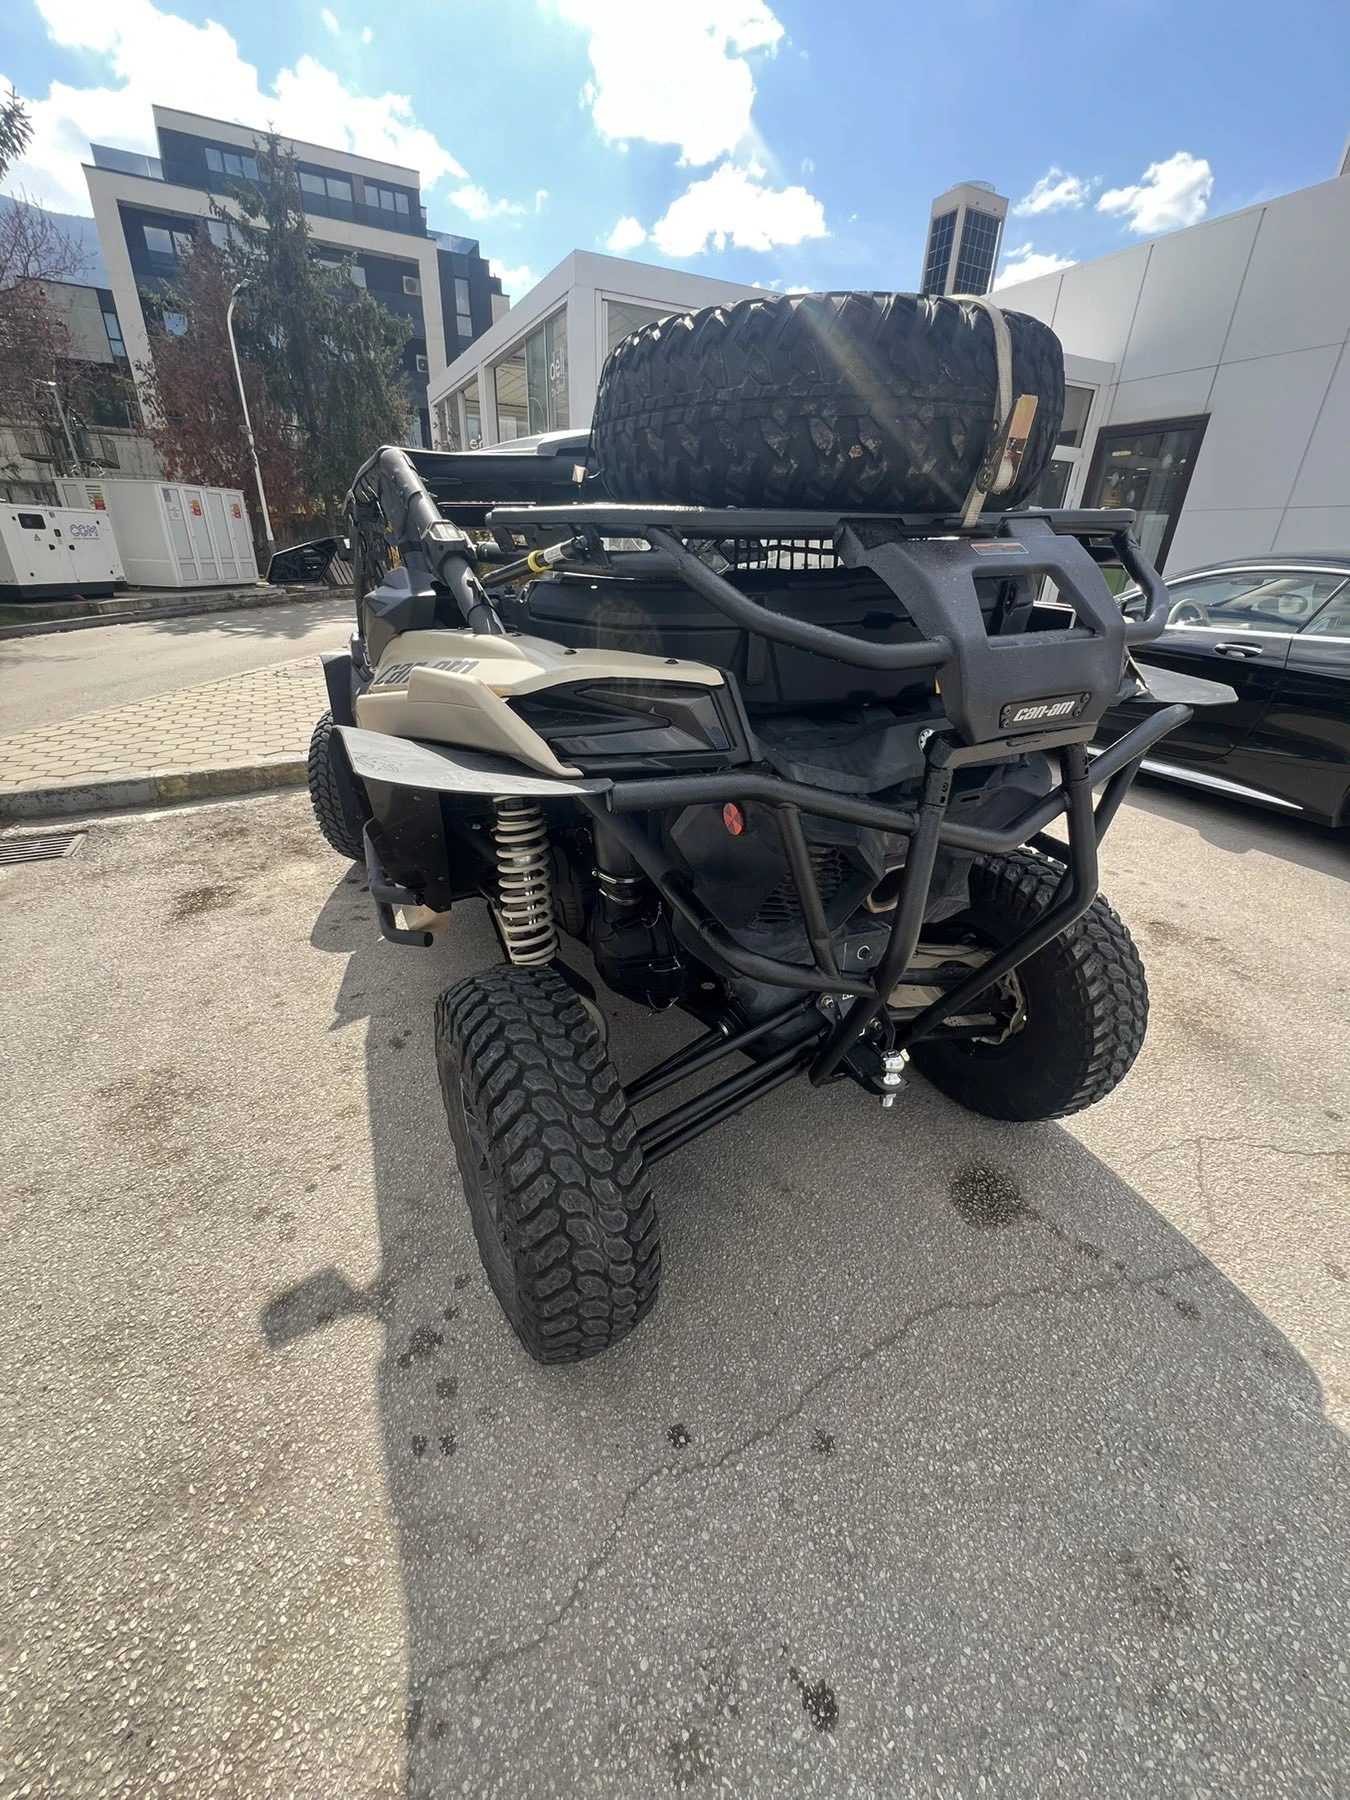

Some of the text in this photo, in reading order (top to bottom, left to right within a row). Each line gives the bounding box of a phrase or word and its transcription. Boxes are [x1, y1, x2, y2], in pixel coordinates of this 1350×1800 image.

[550, 347, 565, 381] deli
[373, 660, 480, 685] canam
[1013, 700, 1075, 722] can-am
